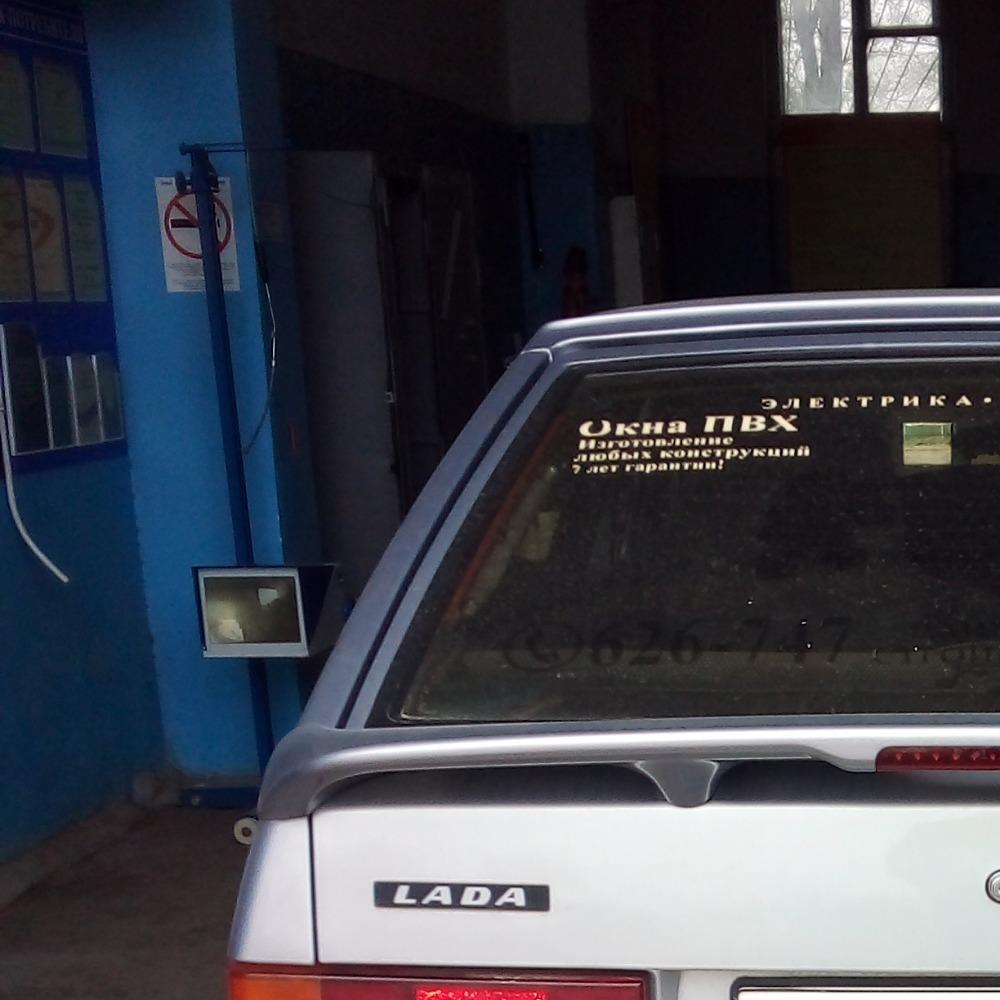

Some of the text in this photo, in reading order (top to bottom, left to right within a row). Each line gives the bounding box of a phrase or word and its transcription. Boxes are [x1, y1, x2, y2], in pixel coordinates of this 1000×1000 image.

[761, 395, 973, 410] ЭЛЕКТРИКА
[578, 414, 800, 437] Окна ПВХ
[578, 435, 735, 450] Изготовление
[572, 445, 812, 463] любых конструкций
[571, 459, 725, 475] 7 лет гарантии!
[393, 884, 527, 907] LADA
